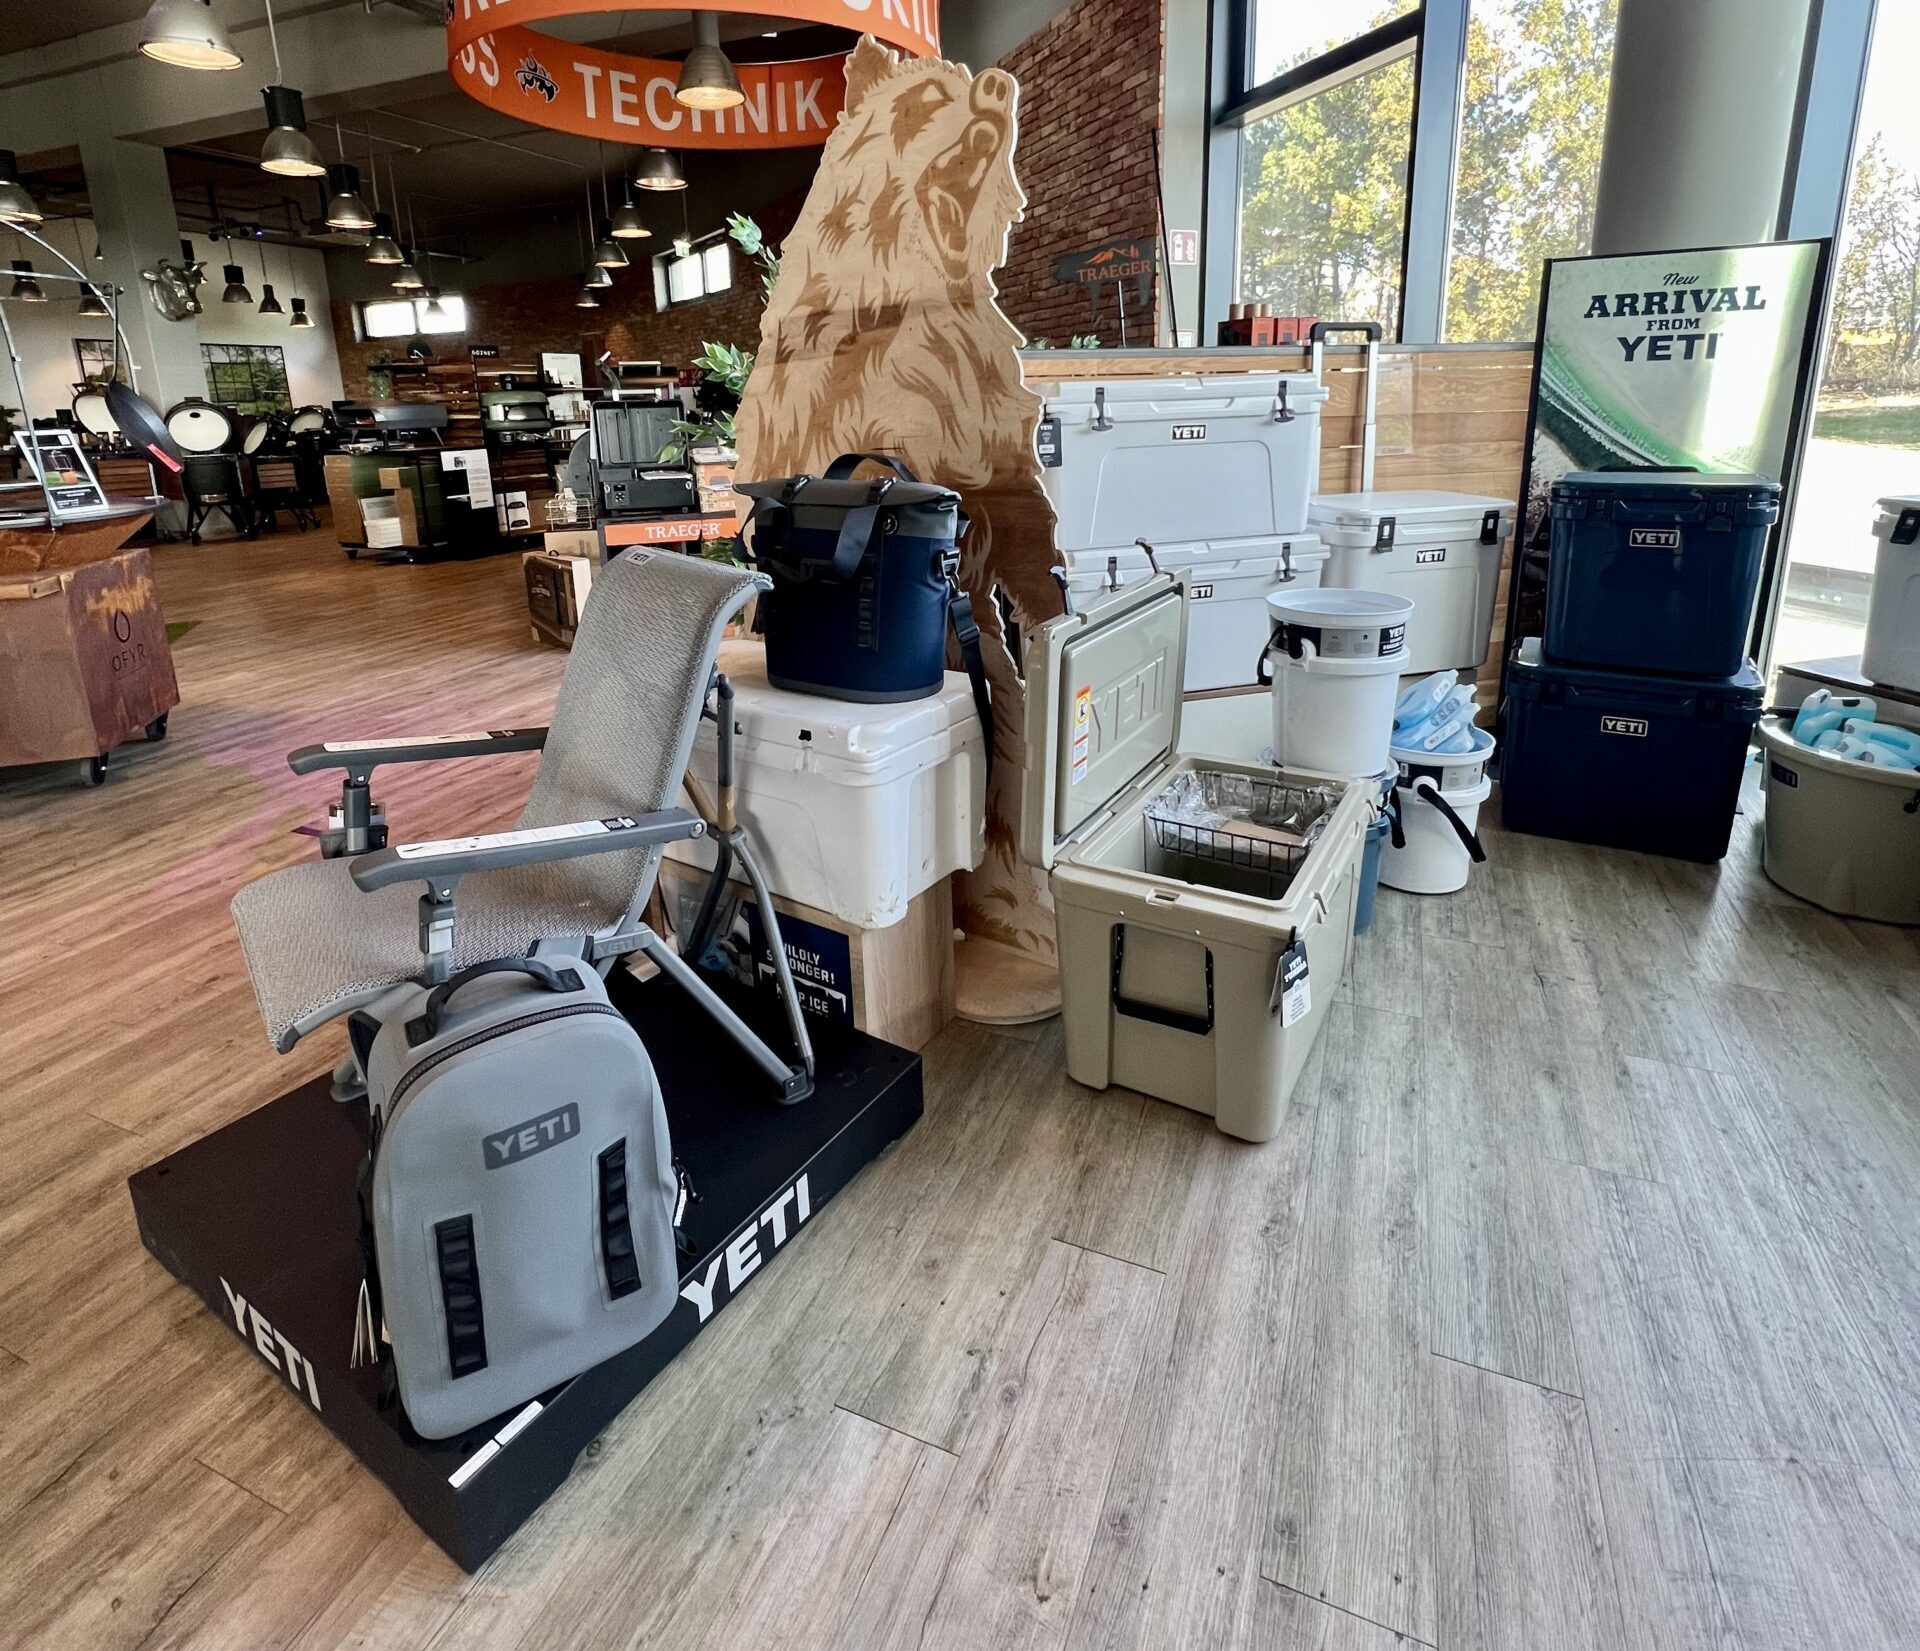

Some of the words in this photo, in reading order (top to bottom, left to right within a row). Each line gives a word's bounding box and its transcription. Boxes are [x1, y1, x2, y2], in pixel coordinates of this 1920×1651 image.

[1075, 260, 1151, 283] TRAEGER
[1663, 272, 1699, 286] New
[1584, 286, 1766, 318] ARRIVAL
[1646, 318, 1701, 331] FROM
[1617, 333, 1719, 362] YETI
[1173, 426, 1205, 439] YETI
[645, 522, 719, 539] TRAEGER
[1634, 531, 1676, 545] YETI
[1417, 551, 1444, 562] YETI
[1190, 587, 1211, 598] ETI
[112, 644, 146, 672] OFYR
[1605, 719, 1644, 734] YETI
[766, 949, 835, 985] SONGER!
[809, 995, 829, 1014] ICE
[490, 1111, 572, 1160] YETI
[680, 1173, 811, 1324] YETI
[219, 1275, 322, 1412] YETI
